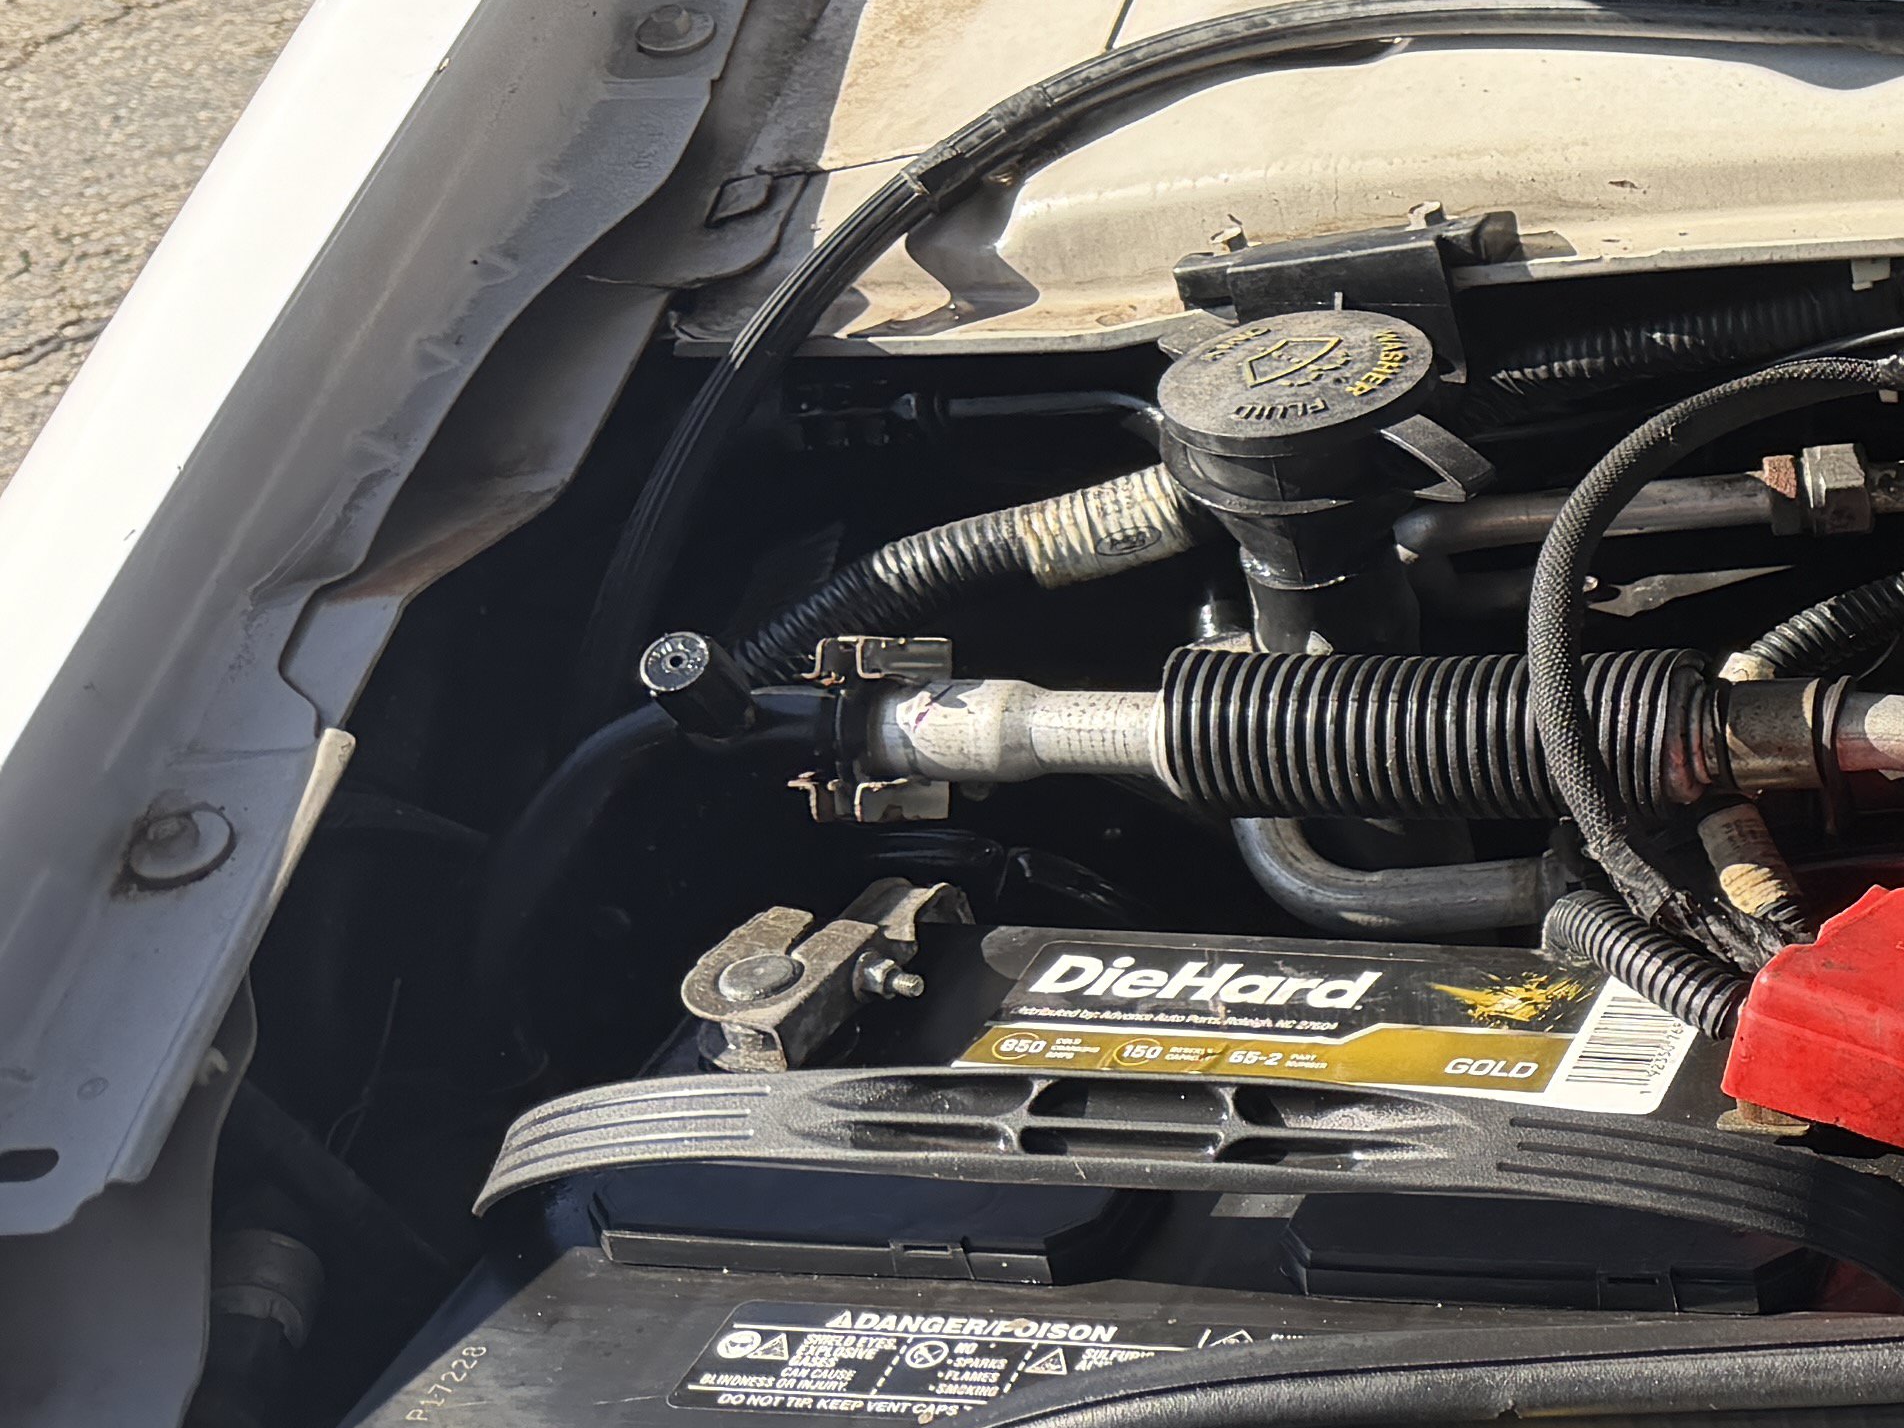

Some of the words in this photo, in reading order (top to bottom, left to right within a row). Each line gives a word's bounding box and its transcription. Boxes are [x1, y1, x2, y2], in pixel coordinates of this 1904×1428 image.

[1345, 329, 1409, 397] WASHER
[1230, 397, 1329, 420] FLUID
[1029, 954, 1382, 1008] DieHard
[1000, 1039, 1047, 1053] 850
[1123, 1045, 1163, 1059] 150
[1443, 1058, 1539, 1079] GOLD
[804, 1334, 856, 1347] SHIELD
[954, 1343, 978, 1354] NO
[796, 1345, 880, 1360] EXPLOSIVE
[789, 1356, 838, 1367] GASES
[700, 1373, 774, 1388] BLINDNESS
[781, 1368, 808, 1378] CAN
[811, 1369, 855, 1380] CAUSE
[718, 1394, 745, 1405] DO
[747, 1394, 785, 1407] NOT
[817, 1398, 863, 1411] KEEP
[866, 1400, 911, 1413] VENT
[913, 1402, 959, 1416] CAPS
